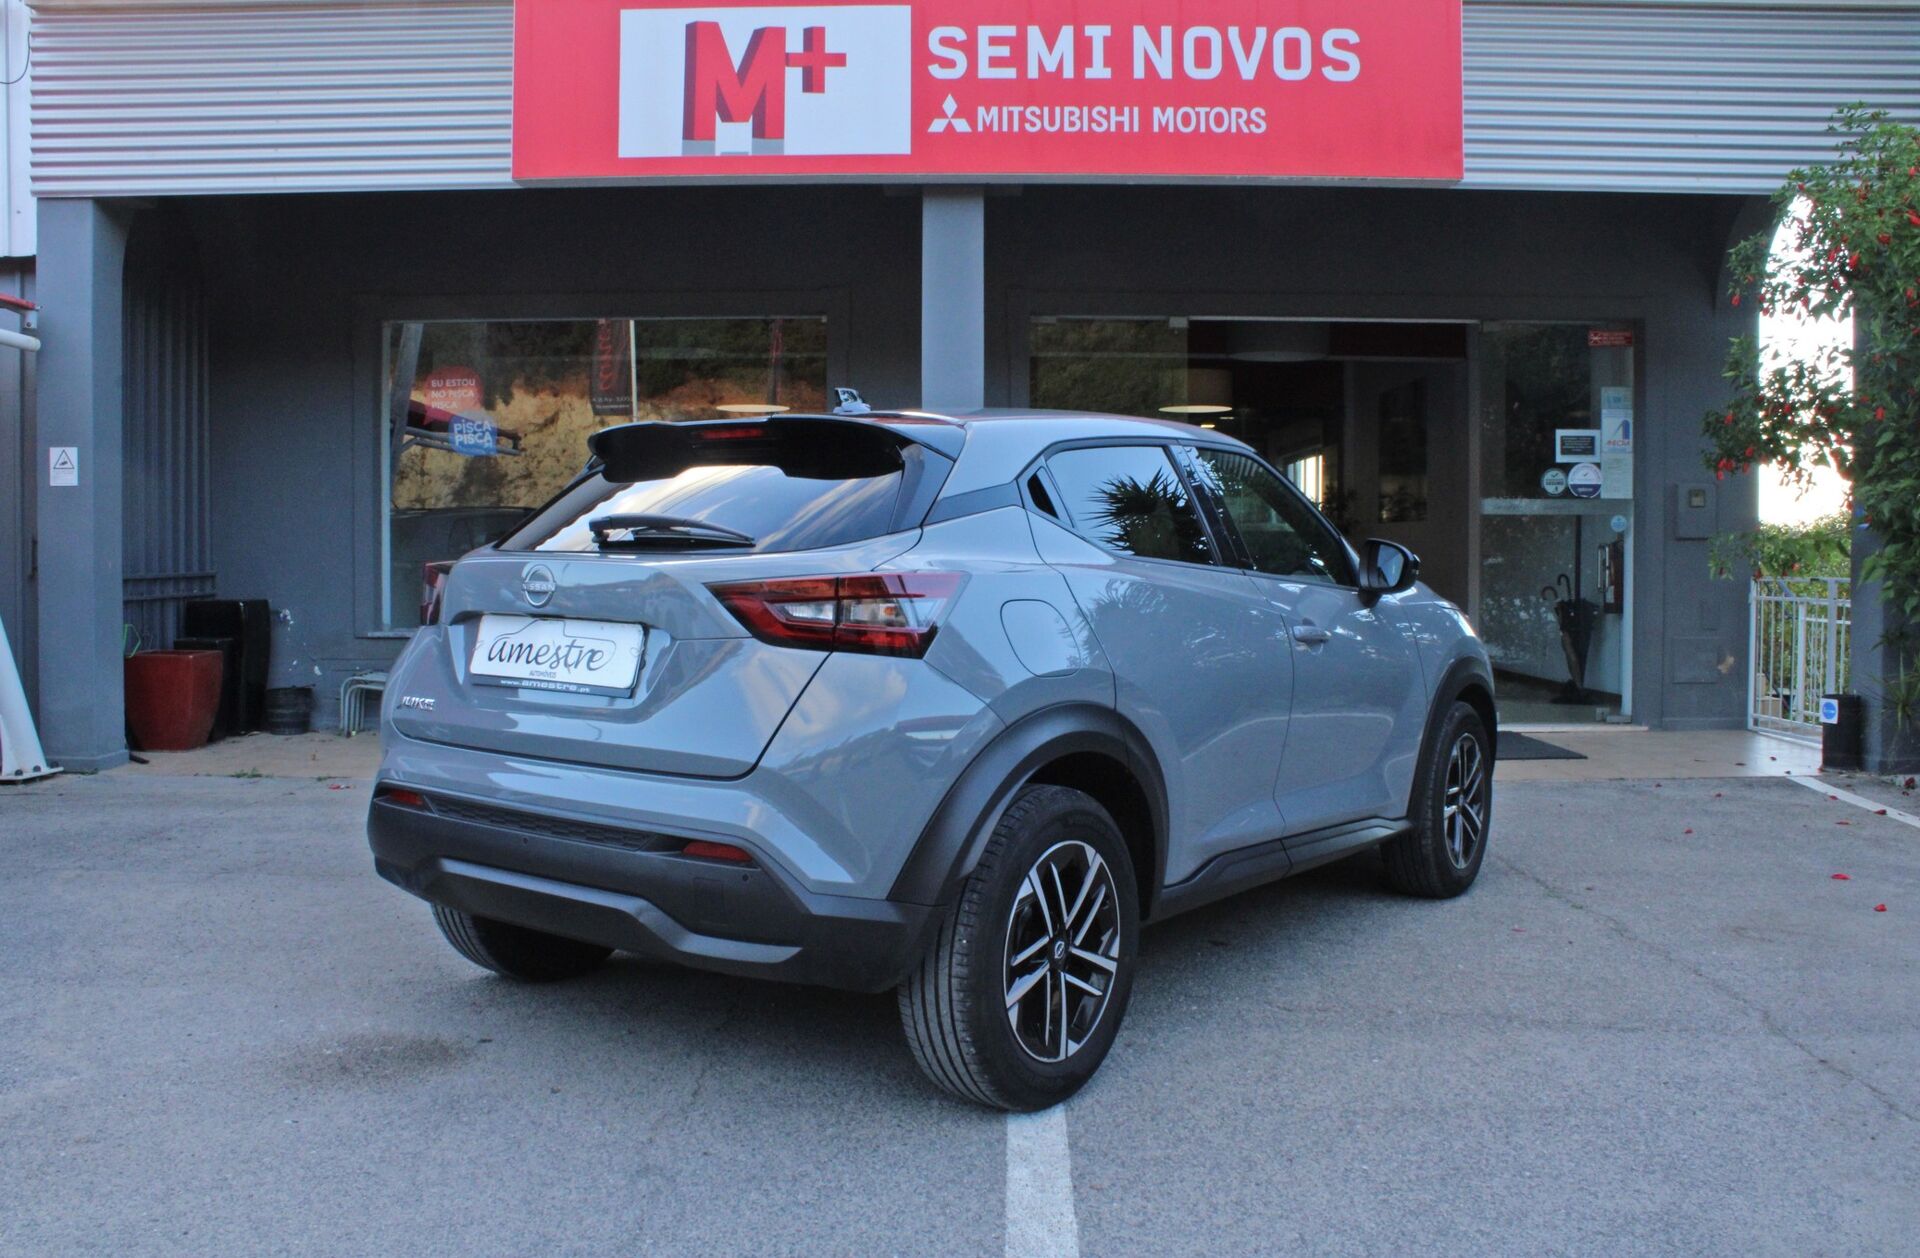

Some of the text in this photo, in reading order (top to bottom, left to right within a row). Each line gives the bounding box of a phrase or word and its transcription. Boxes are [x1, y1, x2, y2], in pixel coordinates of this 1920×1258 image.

[926, 25, 1363, 83] SEMI NOVOS
[976, 105, 1268, 134] MITSUBISHI MOTORS
[431, 378, 476, 388] EU ESTOU
[487, 637, 605, 672] amestre
[500, 678, 590, 694] www.amestre.pt
